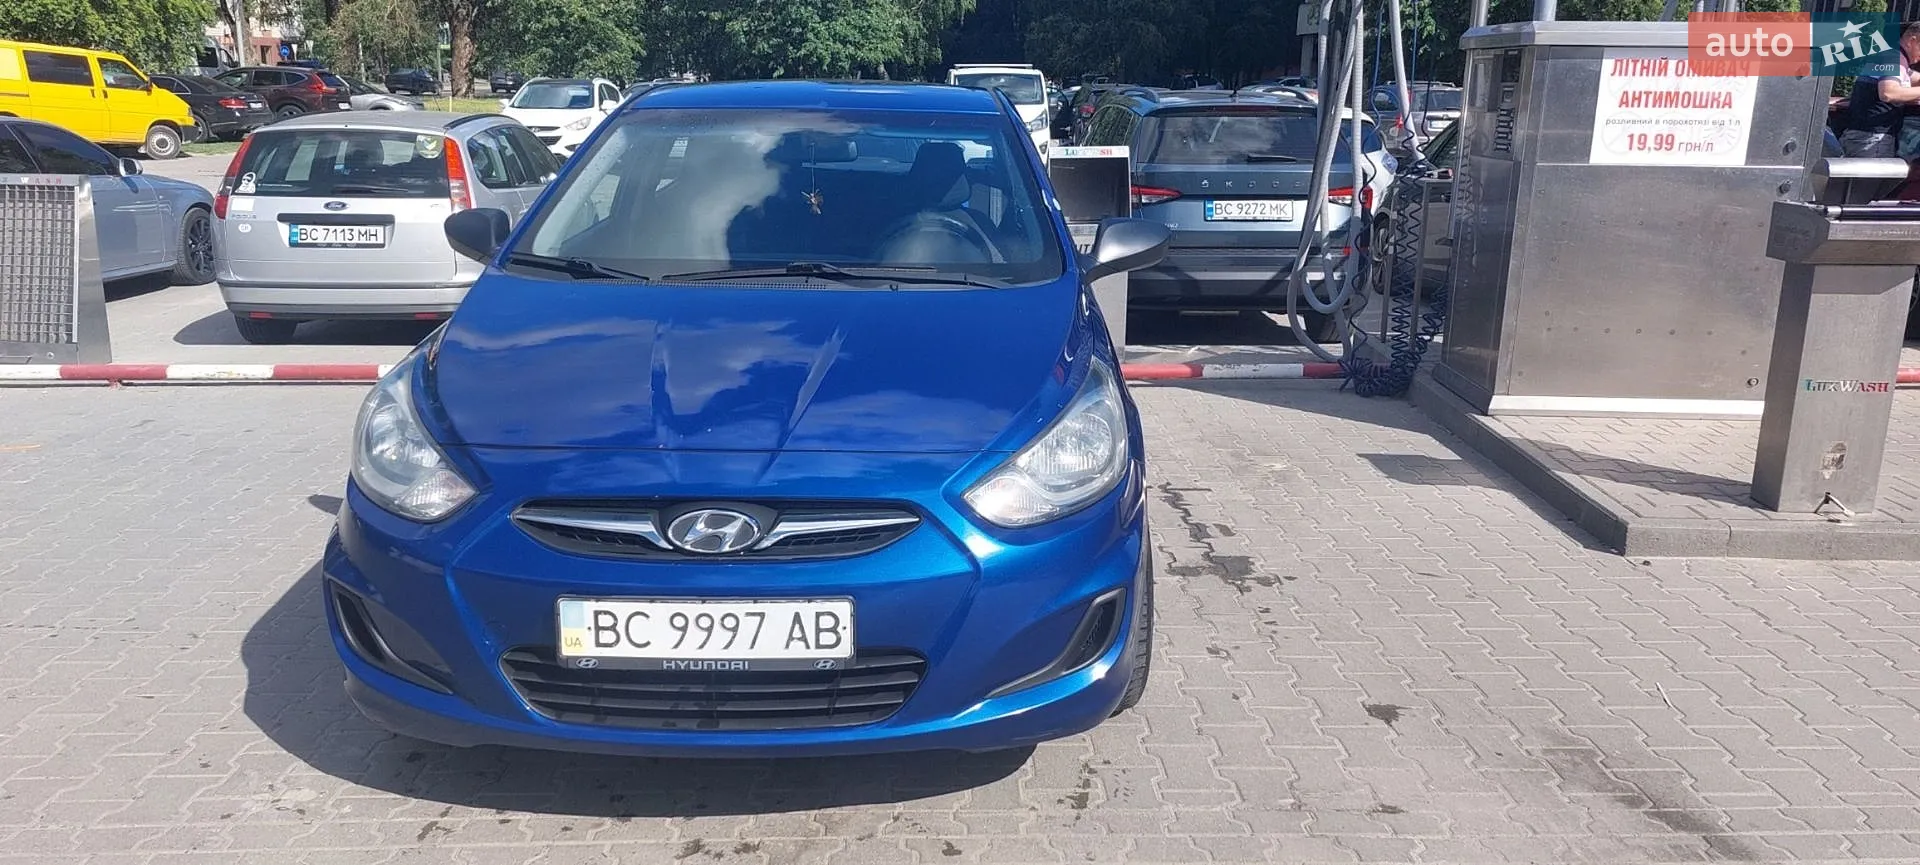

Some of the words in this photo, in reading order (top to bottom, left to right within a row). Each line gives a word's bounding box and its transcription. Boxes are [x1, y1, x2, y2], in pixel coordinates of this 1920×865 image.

[1610, 56, 1668, 77] ЛІТНІЙ
[1618, 90, 1733, 109] АНТИМОШКА
[1627, 133, 1675, 153] 19,99
[1678, 141, 1714, 155] грн/л
[1215, 203, 1233, 215] BC
[1238, 203, 1266, 215] 9272
[1270, 203, 1288, 215] MK
[299, 228, 318, 241] BC
[322, 228, 354, 241] 7113
[358, 228, 378, 241] MH
[593, 610, 651, 648] BC
[669, 611, 765, 649] 9997
[785, 611, 842, 650] AB
[565, 637, 582, 648] UA
[663, 660, 749, 670] HYUNDAI
